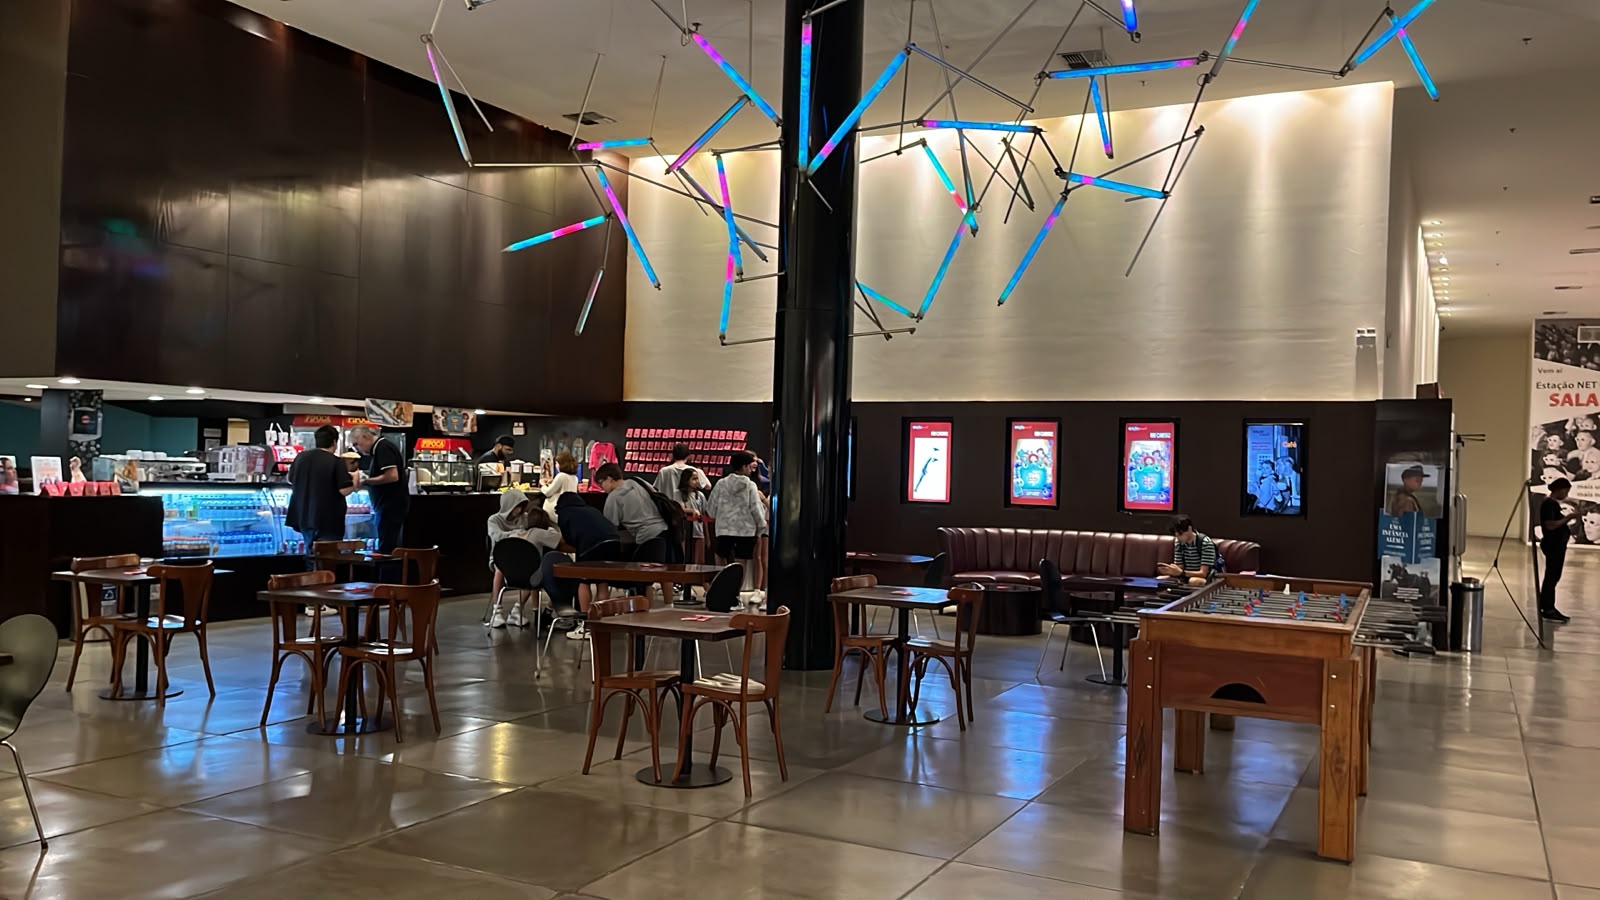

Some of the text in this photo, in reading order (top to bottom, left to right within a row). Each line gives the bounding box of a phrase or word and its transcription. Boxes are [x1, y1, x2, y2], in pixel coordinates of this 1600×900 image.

[1536, 381, 1597, 391] Estação NET
[1549, 392, 1599, 407] SALA
[421, 438, 446, 449] PIPOCA
